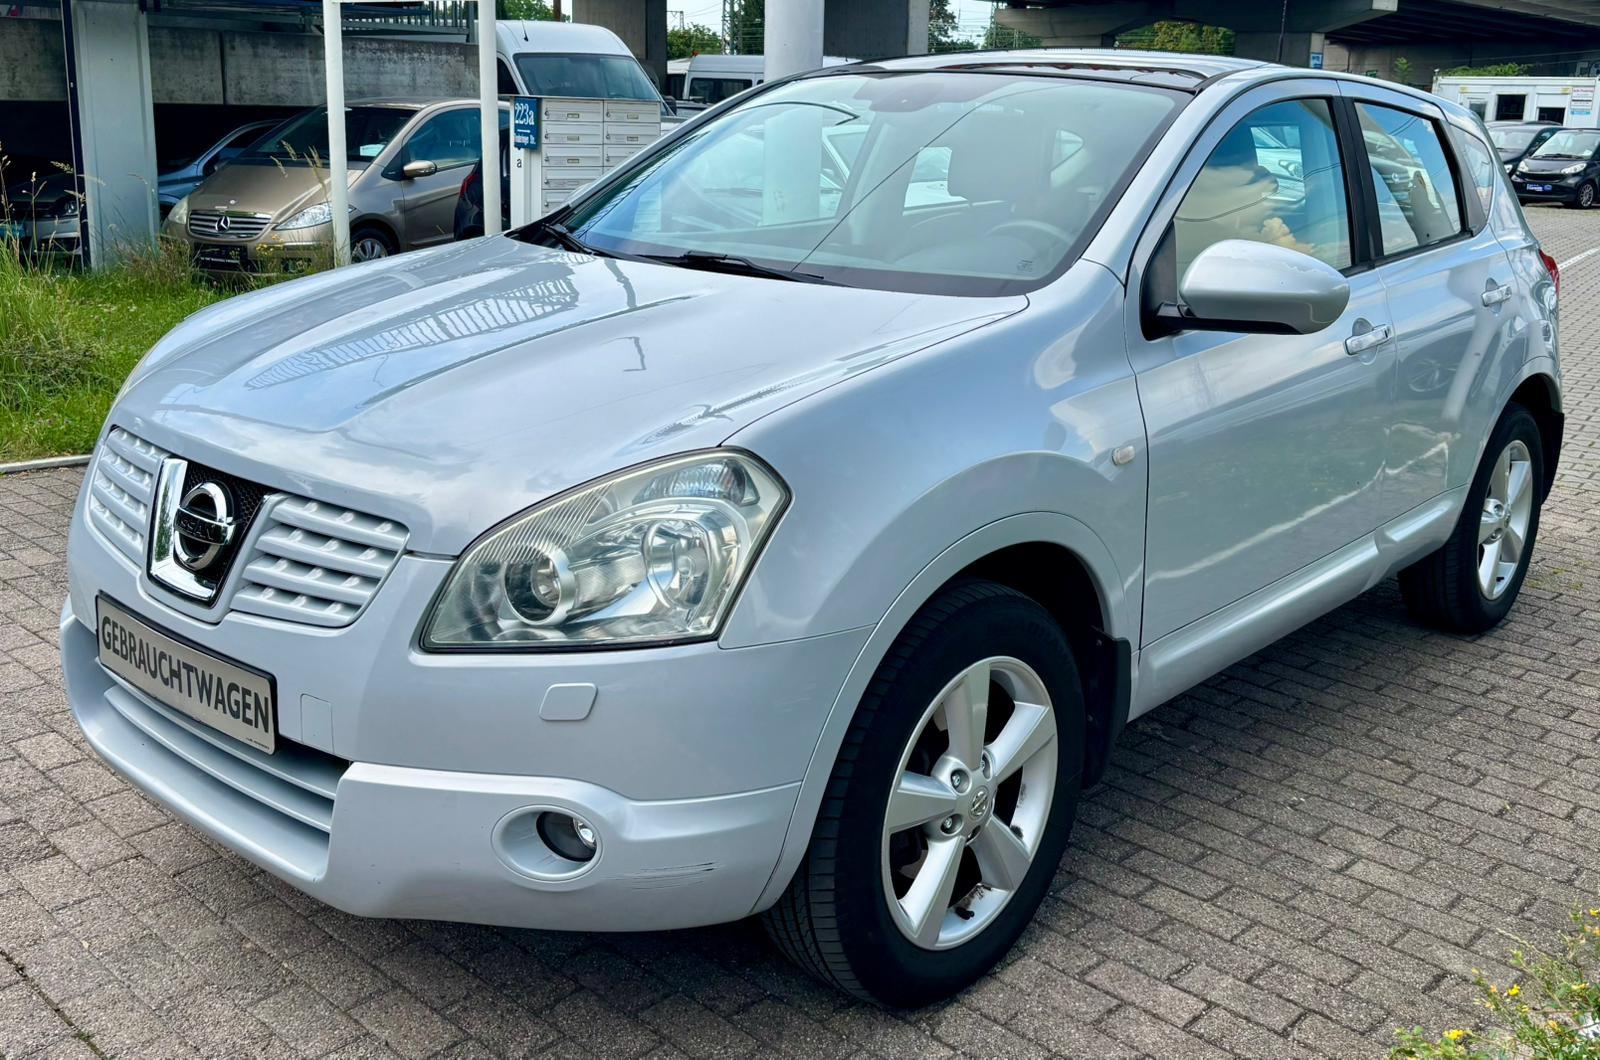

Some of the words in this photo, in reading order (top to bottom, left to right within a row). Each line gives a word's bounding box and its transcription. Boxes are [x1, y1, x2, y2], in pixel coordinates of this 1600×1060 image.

[515, 103, 535, 125] 223a
[516, 158, 522, 168] a
[101, 615, 269, 733] GEBRAUCHTWAGEN
